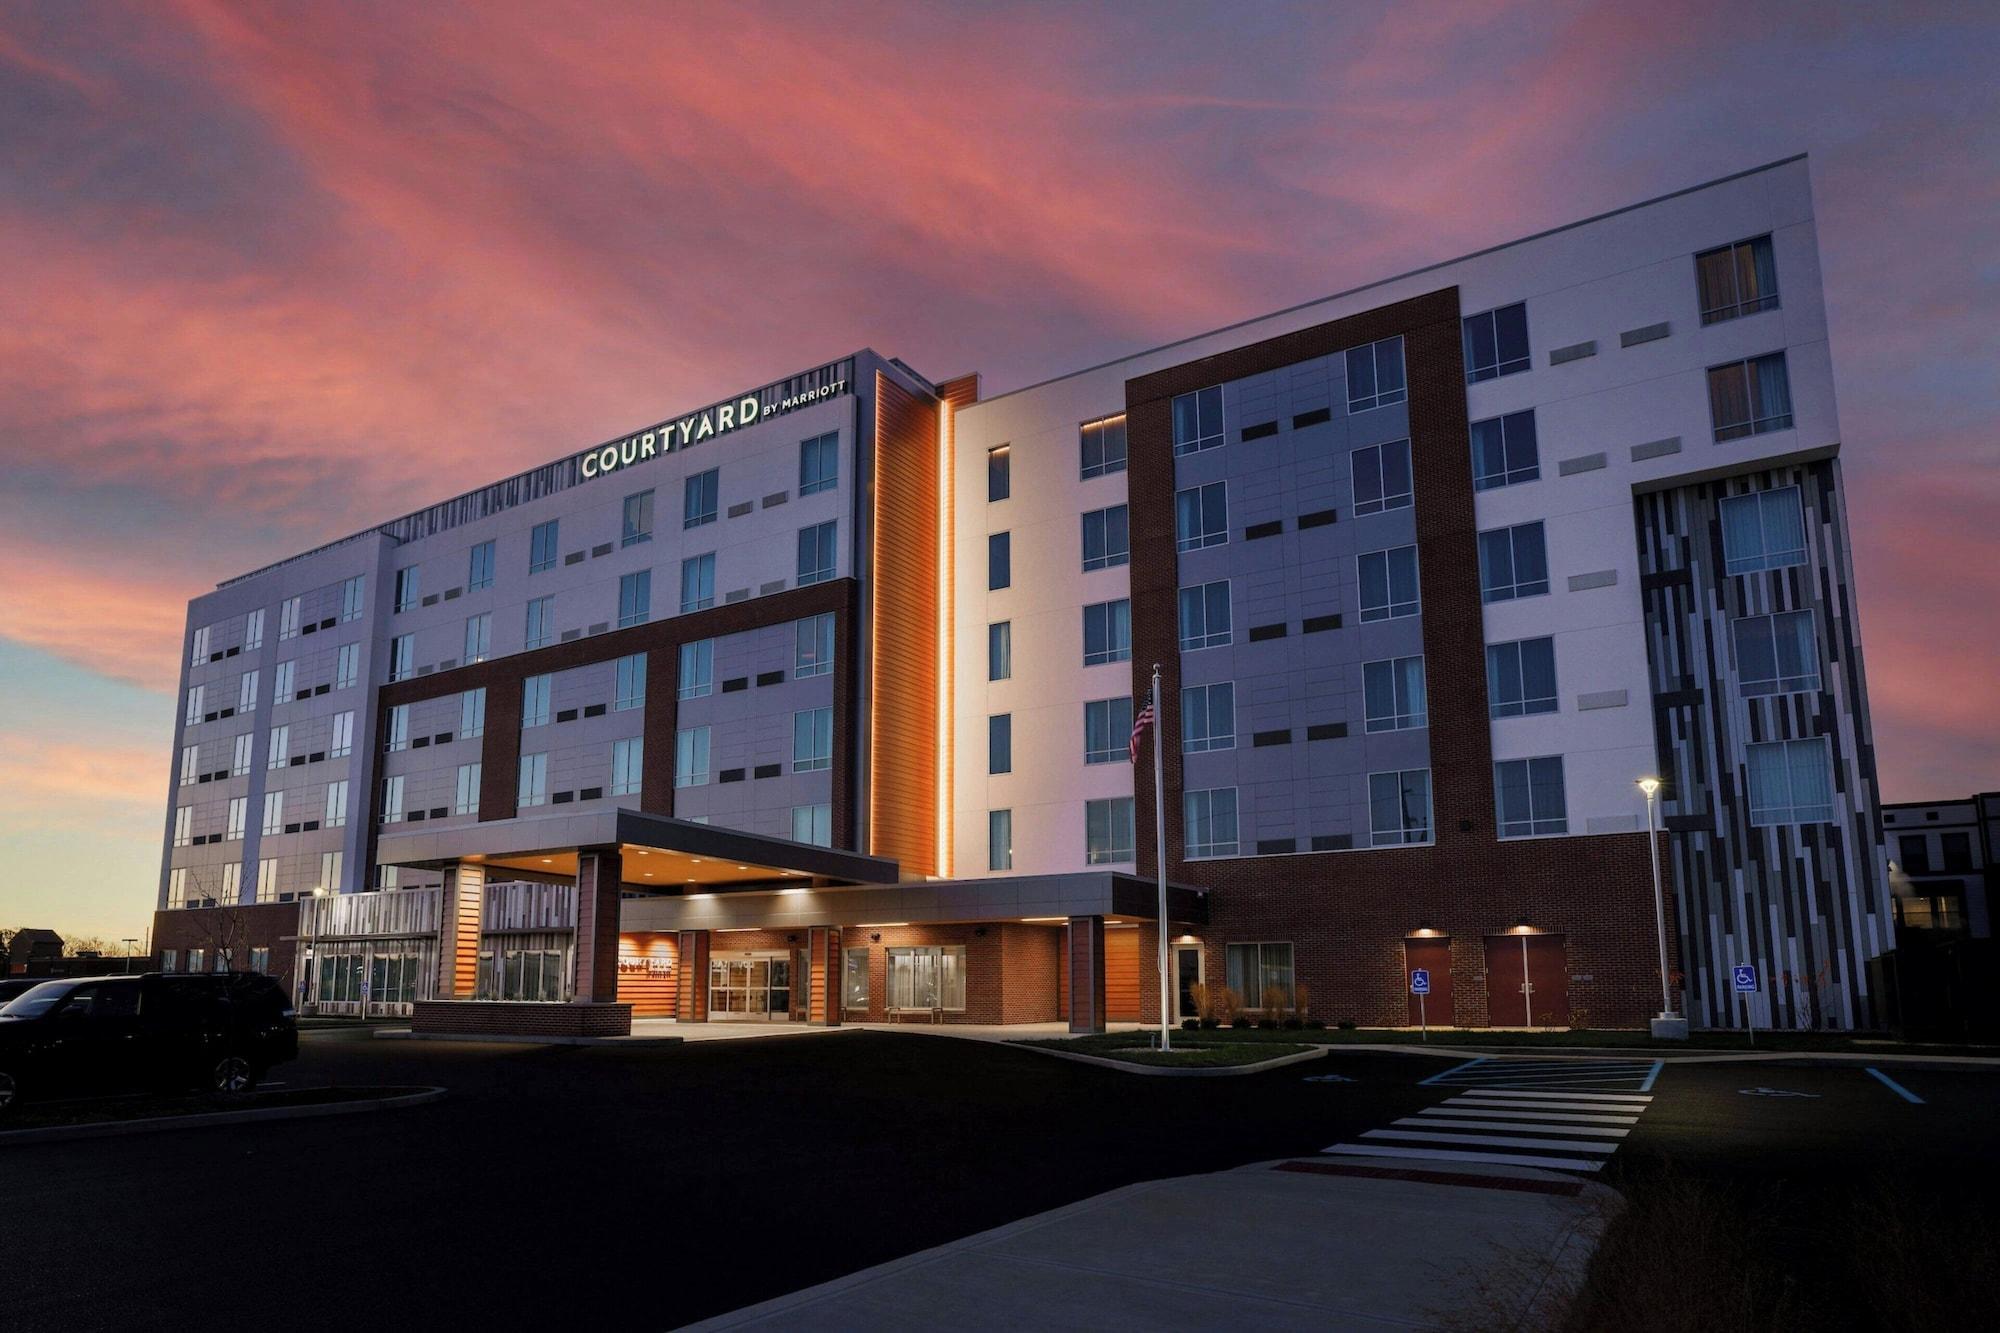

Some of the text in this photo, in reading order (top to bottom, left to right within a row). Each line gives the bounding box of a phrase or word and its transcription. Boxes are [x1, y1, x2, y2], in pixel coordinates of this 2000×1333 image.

[582, 380, 846, 478] COURTYARD BY MARRIOTT
